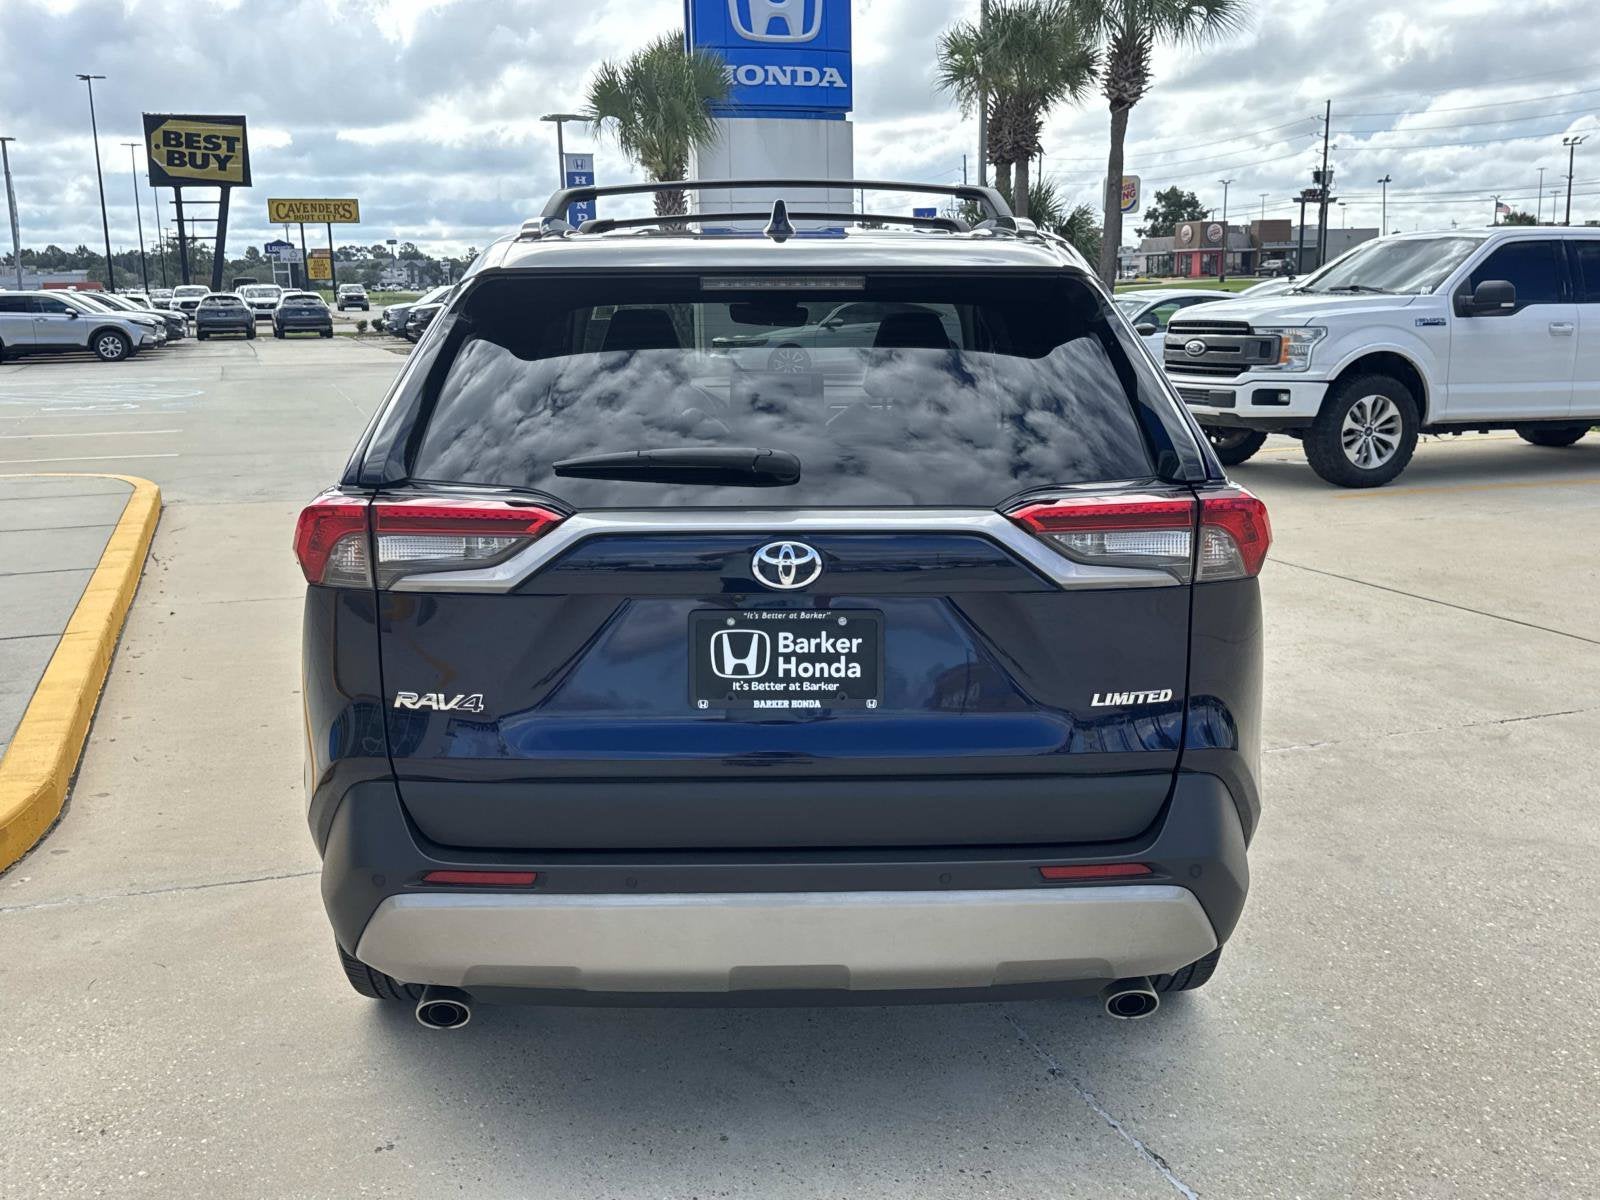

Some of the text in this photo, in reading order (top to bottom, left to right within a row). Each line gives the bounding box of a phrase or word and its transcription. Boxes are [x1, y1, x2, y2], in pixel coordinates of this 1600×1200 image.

[162, 130, 241, 153] BEST
[166, 149, 235, 172] BUY
[1122, 190, 1137, 201] NG
[275, 202, 353, 220] CAVENDER'S
[761, 611, 786, 620] Better
[789, 612, 798, 620] at
[777, 630, 863, 654] Barker
[777, 655, 862, 678] Honda
[732, 681, 840, 691] It's Better at Barker
[393, 691, 484, 713] RAV4
[753, 699, 821, 709] BARKER HONDA
[1090, 688, 1173, 707] LIMITED
